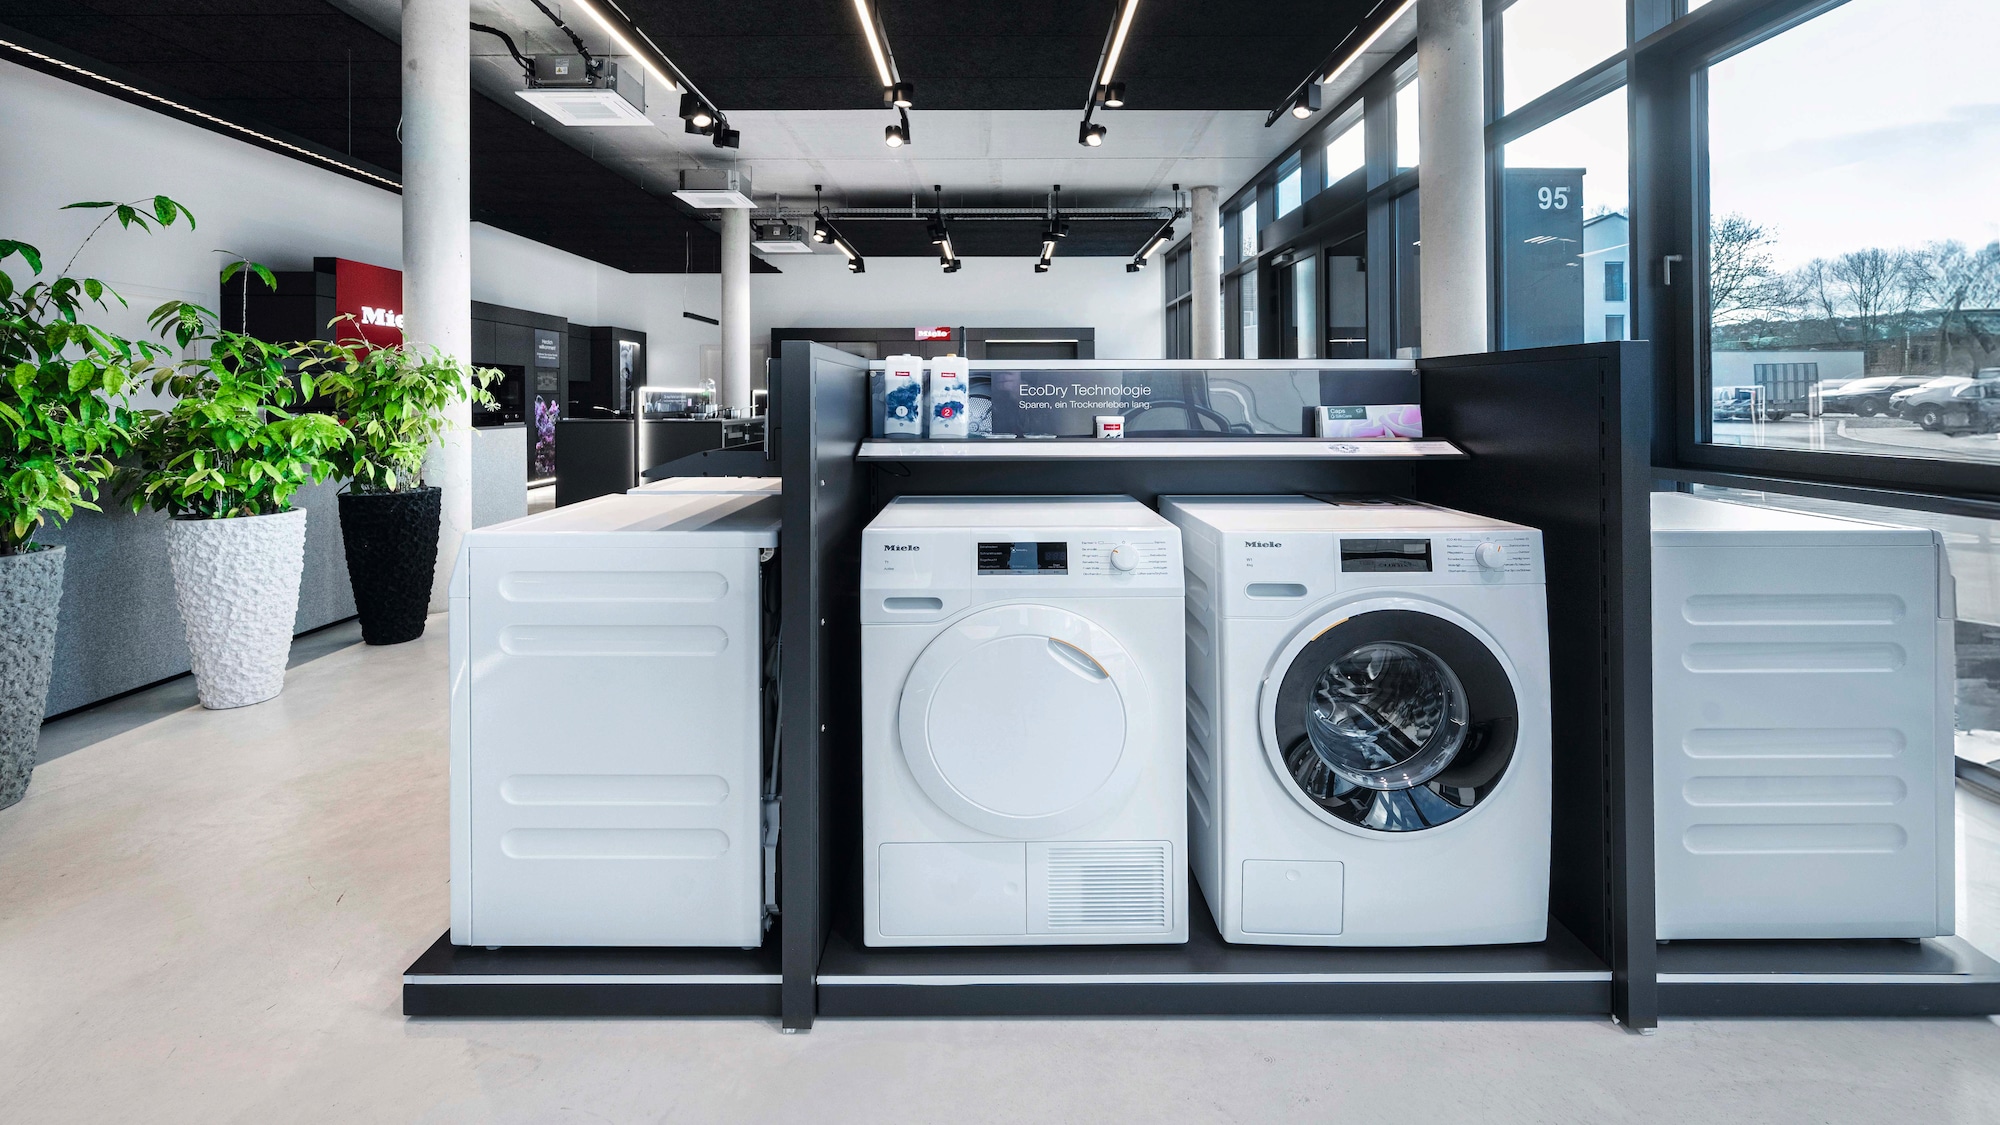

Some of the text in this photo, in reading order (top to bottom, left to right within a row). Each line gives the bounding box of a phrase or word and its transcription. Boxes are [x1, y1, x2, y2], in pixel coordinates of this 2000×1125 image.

[1538, 186, 1568, 210] 95
[1019, 384, 1152, 398] EcoDry Technologie
[1019, 401, 1153, 411] Sparen, ein Trocknerleben lang.
[944, 409, 950, 417] 2
[884, 544, 920, 552] Miele
[1244, 540, 1282, 548] Miele
